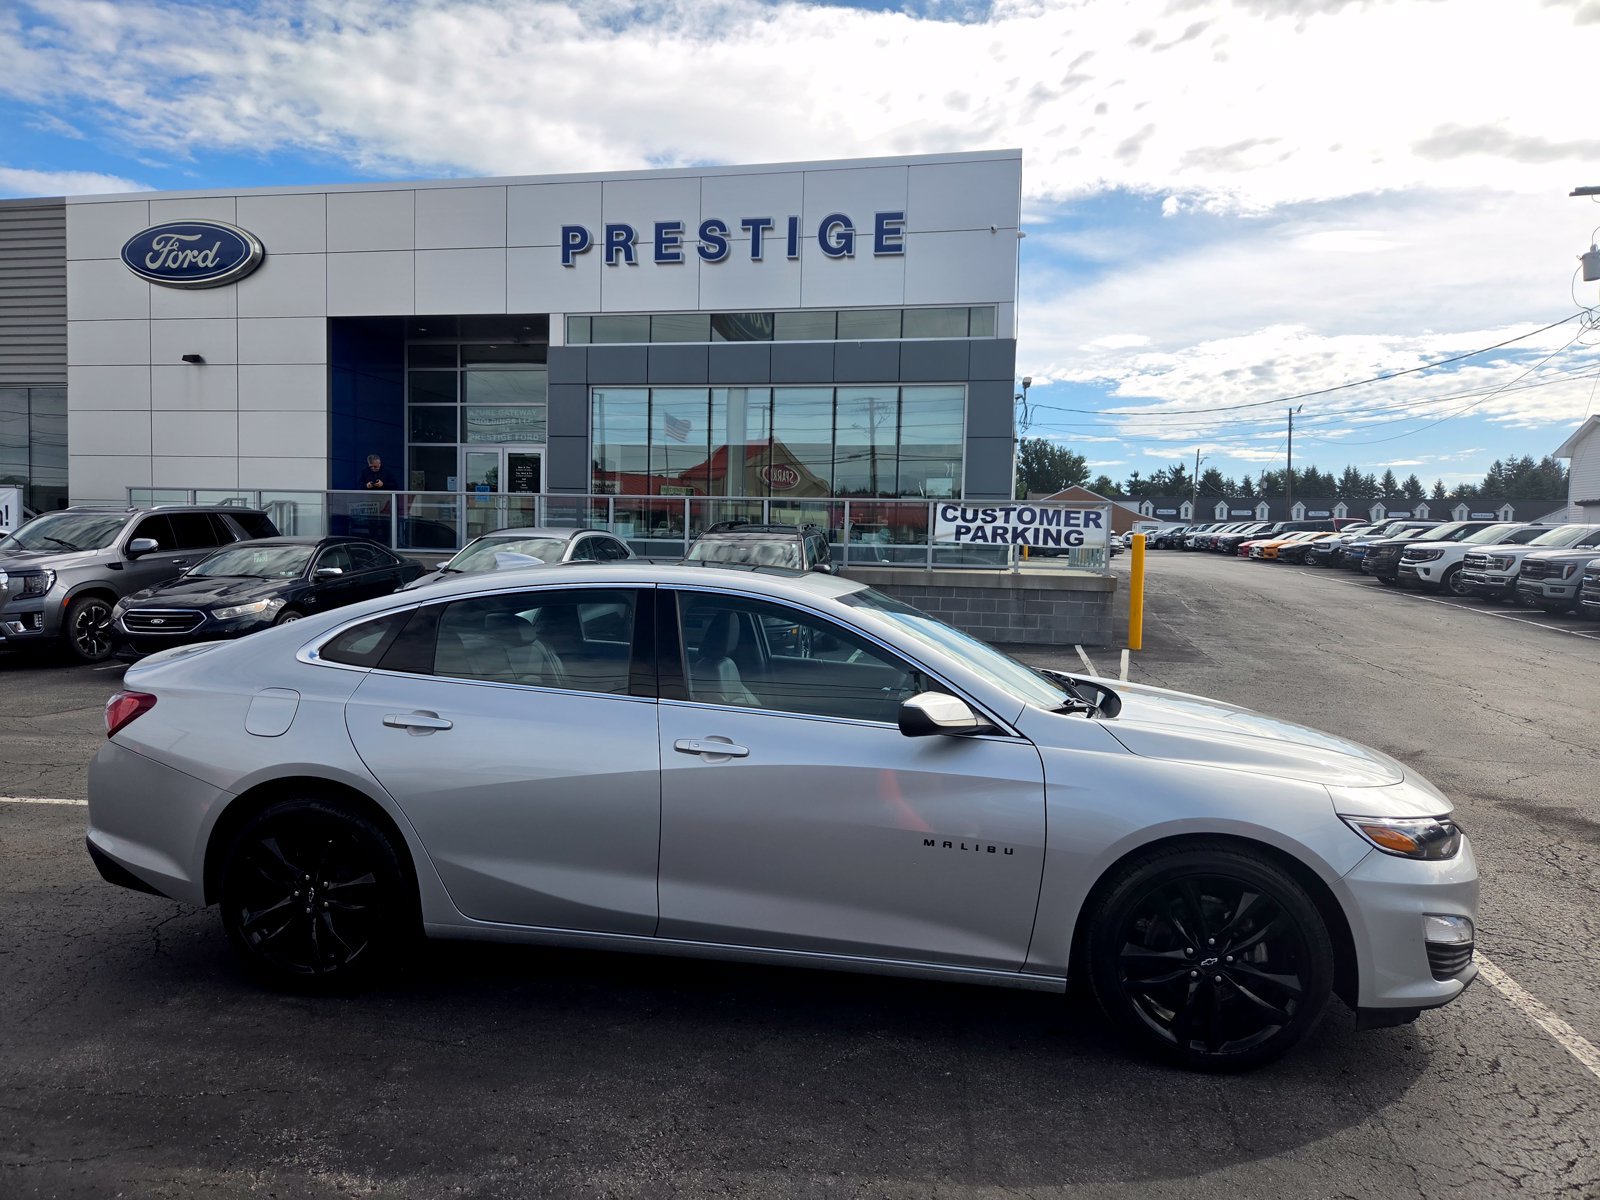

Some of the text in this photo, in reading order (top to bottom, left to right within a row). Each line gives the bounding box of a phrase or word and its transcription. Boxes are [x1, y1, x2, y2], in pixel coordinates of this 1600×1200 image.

[560, 210, 906, 267] PRESTIGE
[145, 233, 221, 270] Ford
[470, 433, 539, 441] PRESTIGE FORD
[940, 504, 1102, 529] CUSTOMER
[954, 524, 1084, 547] PARKING
[923, 838, 1014, 856] MALIBU
